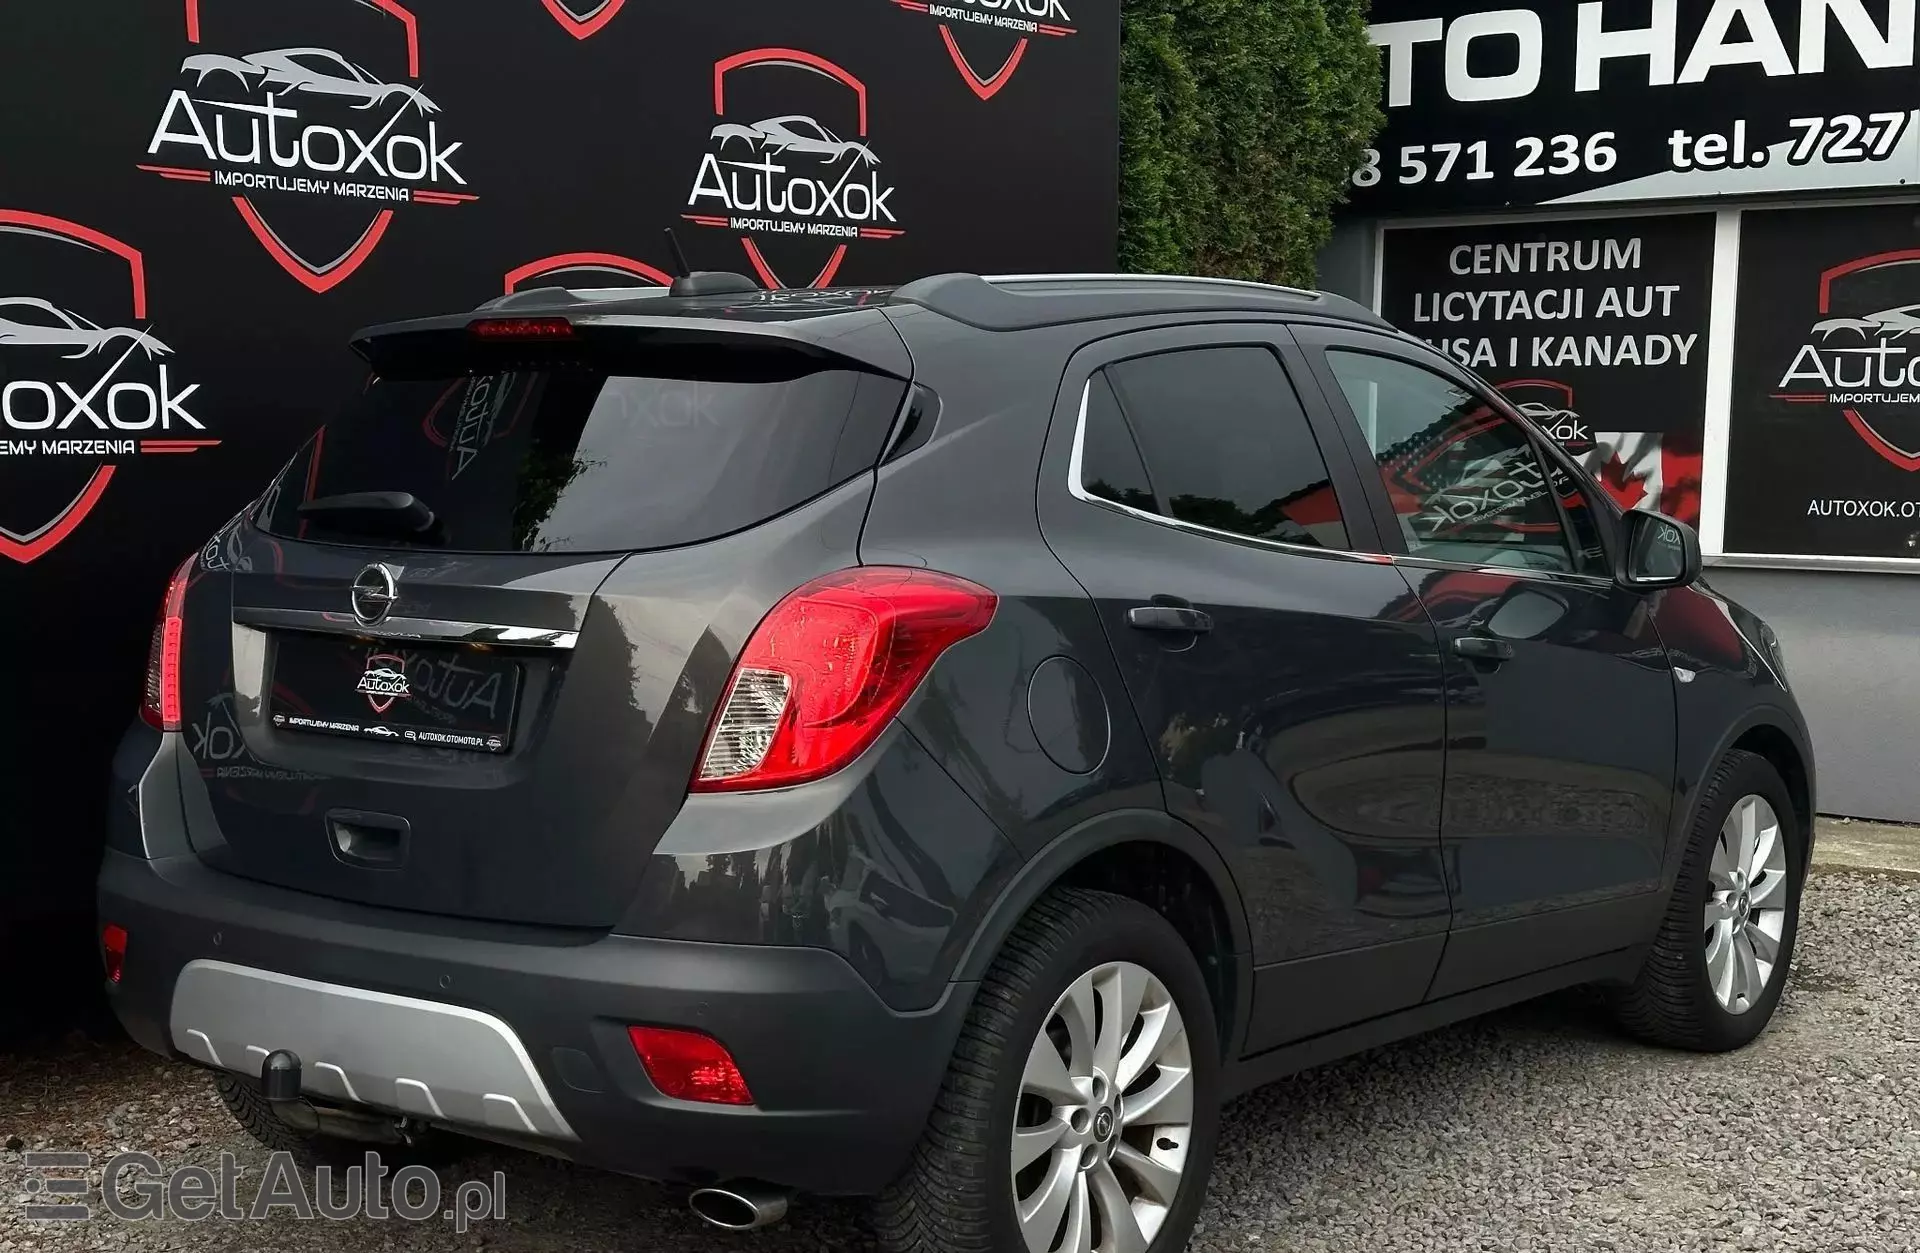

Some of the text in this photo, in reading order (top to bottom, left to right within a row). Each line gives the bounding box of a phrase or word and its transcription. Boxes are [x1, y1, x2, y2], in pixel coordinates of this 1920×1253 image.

[929, 4, 993, 25] IMPORTUJEMY
[994, 15, 1038, 33] MARZENIA
[1575, 0, 1914, 92] HAN
[147, 84, 467, 185] Autoxok
[1399, 140, 1494, 185] 571
[1514, 131, 1617, 177] 236
[1669, 119, 1769, 169] tel.
[1788, 111, 1905, 163] 727
[214, 170, 410, 202] IMPORTUJEMY MARZENIA
[687, 143, 897, 222] Autoxok
[730, 216, 858, 238] IMPORTUJEMY MARZENIA
[1449, 237, 1642, 275] CENTRUM
[1414, 285, 1680, 322] LICYTACJI AUT
[1509, 336, 1518, 367] I
[1531, 334, 1698, 367] KANADY
[42, 440, 135, 455] MARZENIA
[356, 675, 410, 694] Autoxok
